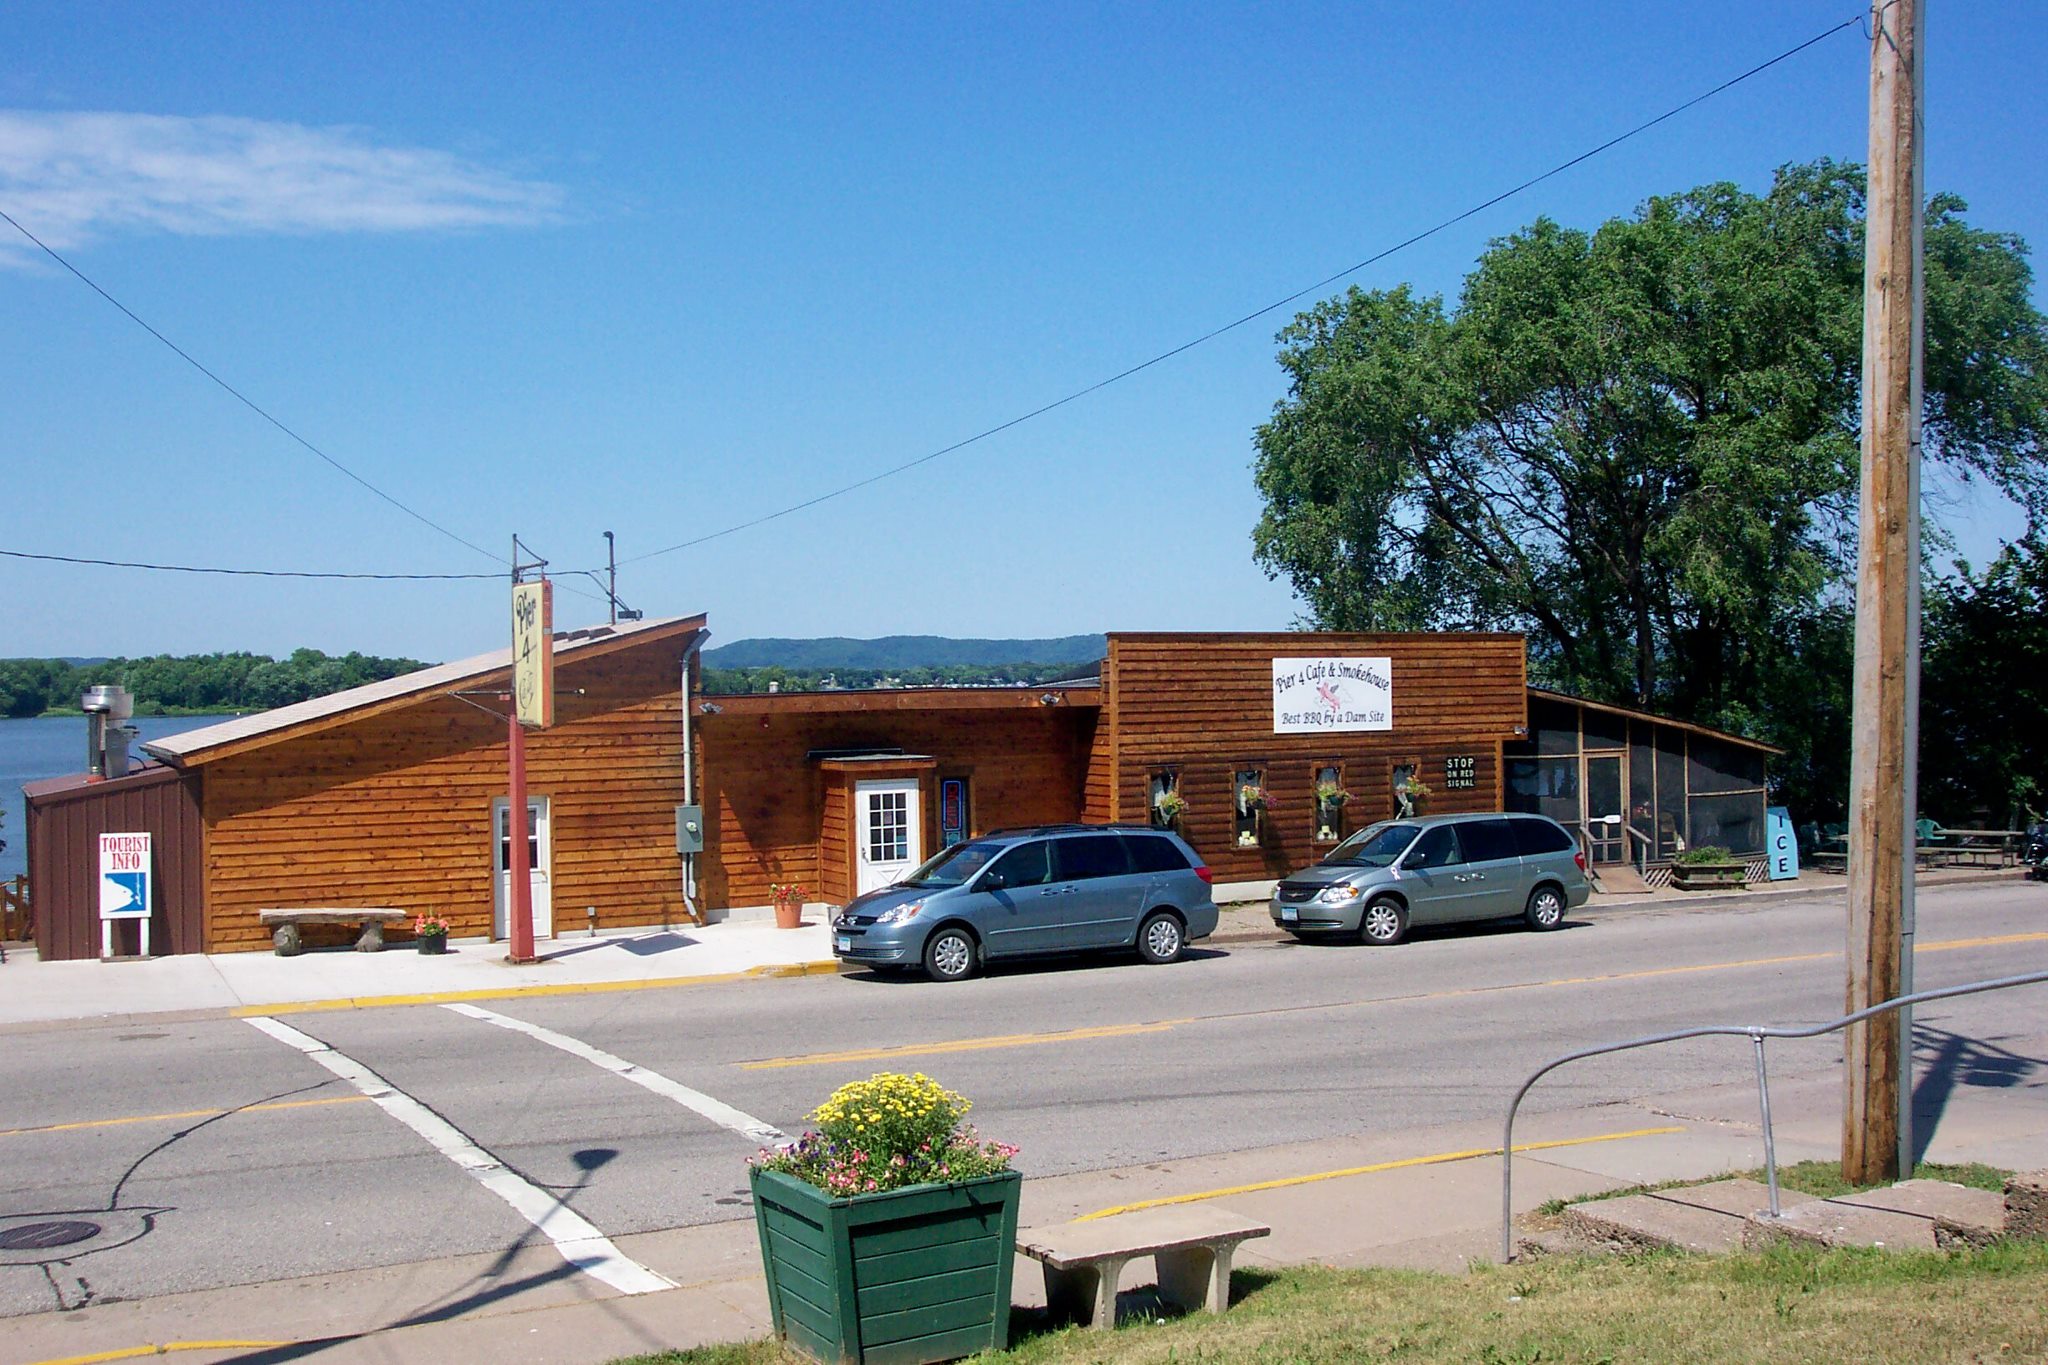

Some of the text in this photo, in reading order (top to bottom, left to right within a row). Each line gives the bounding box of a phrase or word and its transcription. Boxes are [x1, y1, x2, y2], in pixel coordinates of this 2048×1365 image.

[516, 591, 536, 635] Pier
[1276, 660, 1390, 693] Pier 4 Cafe & Smokehouse
[1281, 710, 1385, 727] Best BBQ by a Dam Site
[1447, 758, 1474, 768] STOP
[1447, 769, 1474, 778] ON RED
[1447, 779, 1475, 787] SIGNAL
[102, 836, 149, 852] TOURIST
[1776, 815, 1788, 873] ICE
[112, 852, 140, 870] INFO
